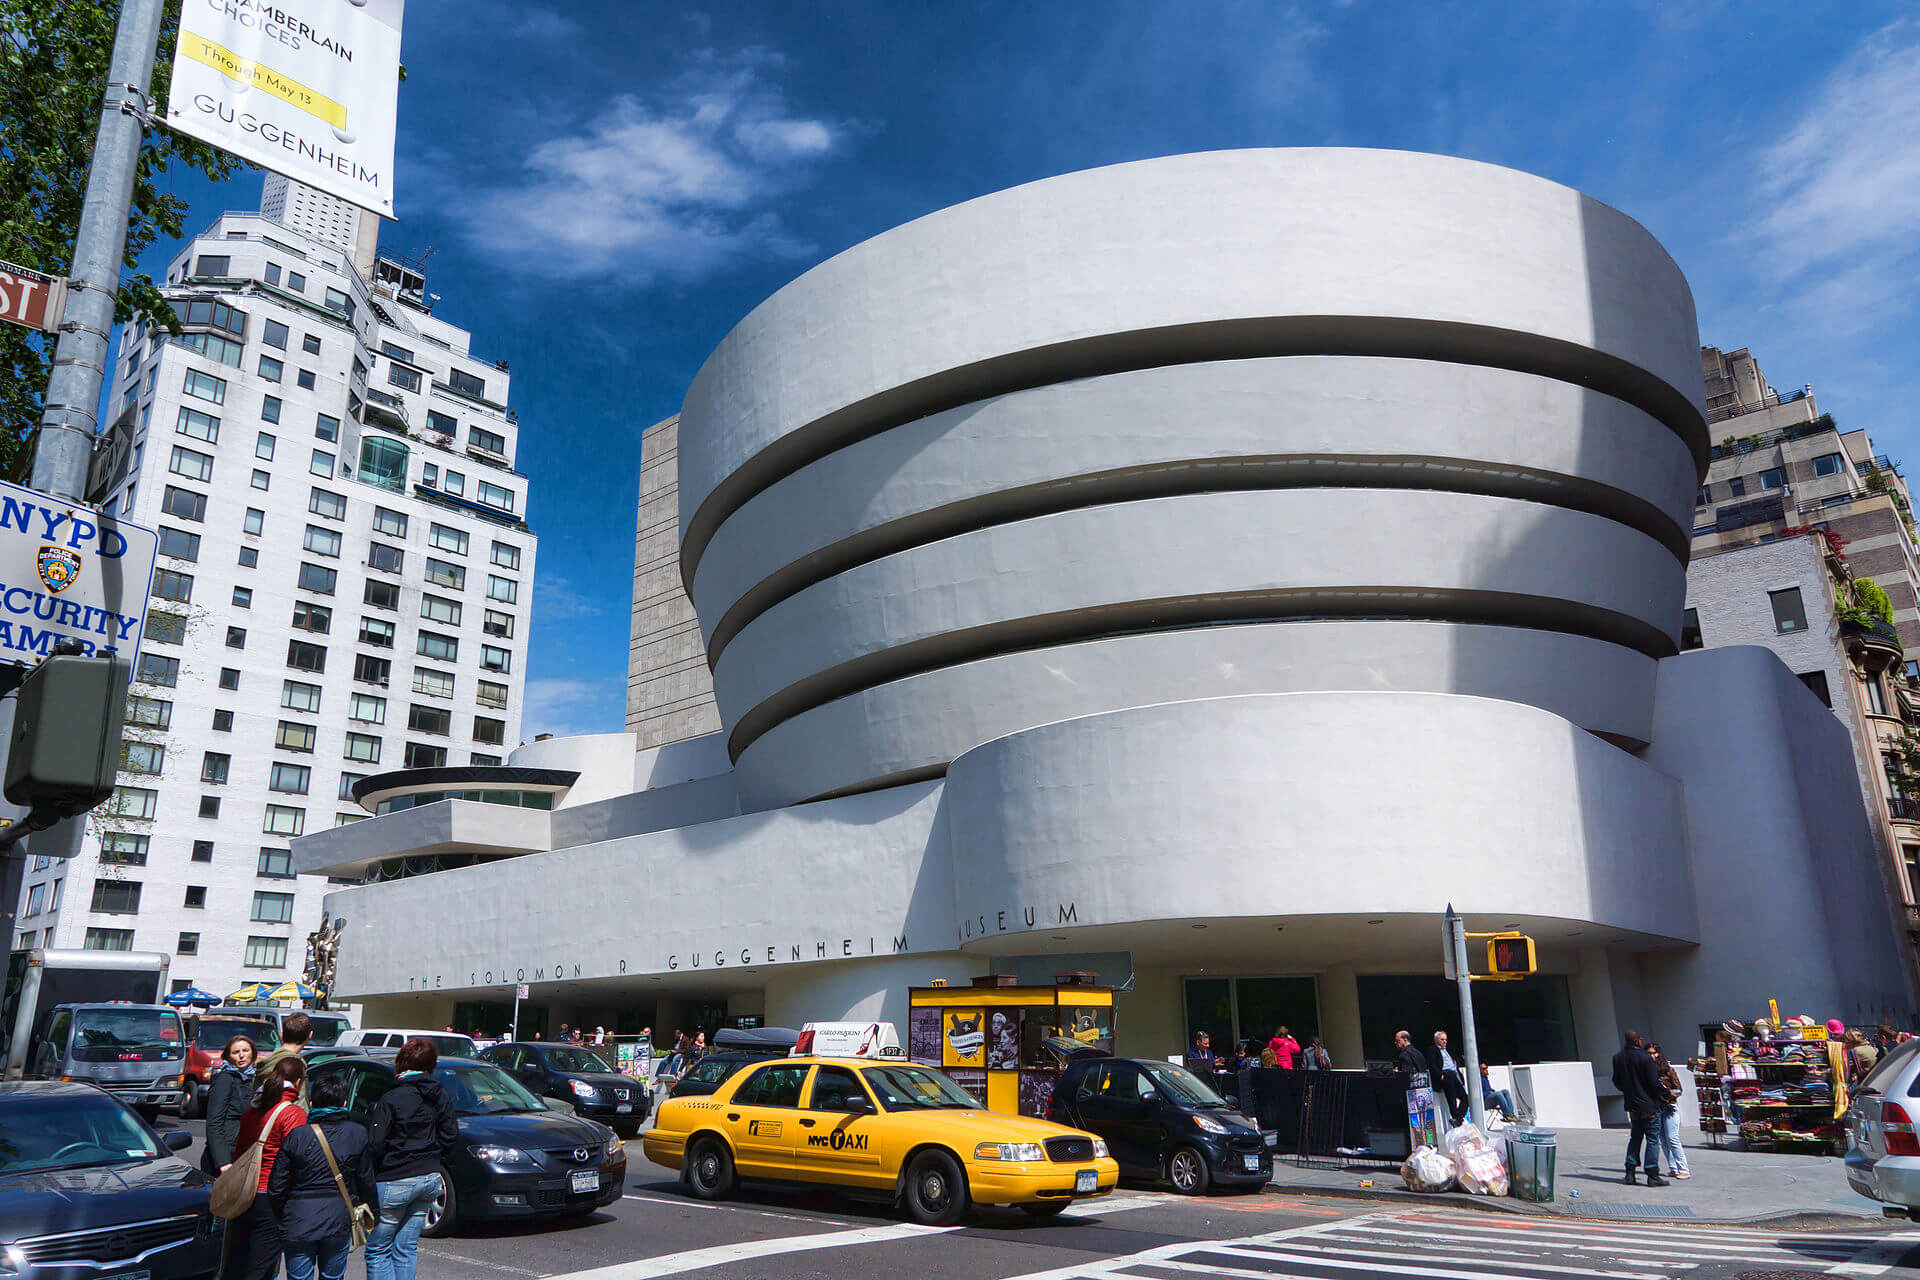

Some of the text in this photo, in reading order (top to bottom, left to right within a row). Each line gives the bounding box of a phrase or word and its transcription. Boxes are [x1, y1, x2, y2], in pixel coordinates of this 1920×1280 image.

[208, 0, 301, 50] CHOICES
[201, 43, 312, 105] Through May 13
[193, 93, 379, 188] GUGGENHEIM
[0, 496, 128, 559] NYPD
[409, 976, 441, 991] THE
[471, 964, 581, 985] SOLOMON
[619, 959, 627, 974] R
[668, 935, 909, 970] GUGGENHEIM
[808, 1128, 869, 1150] NYC TAXI
